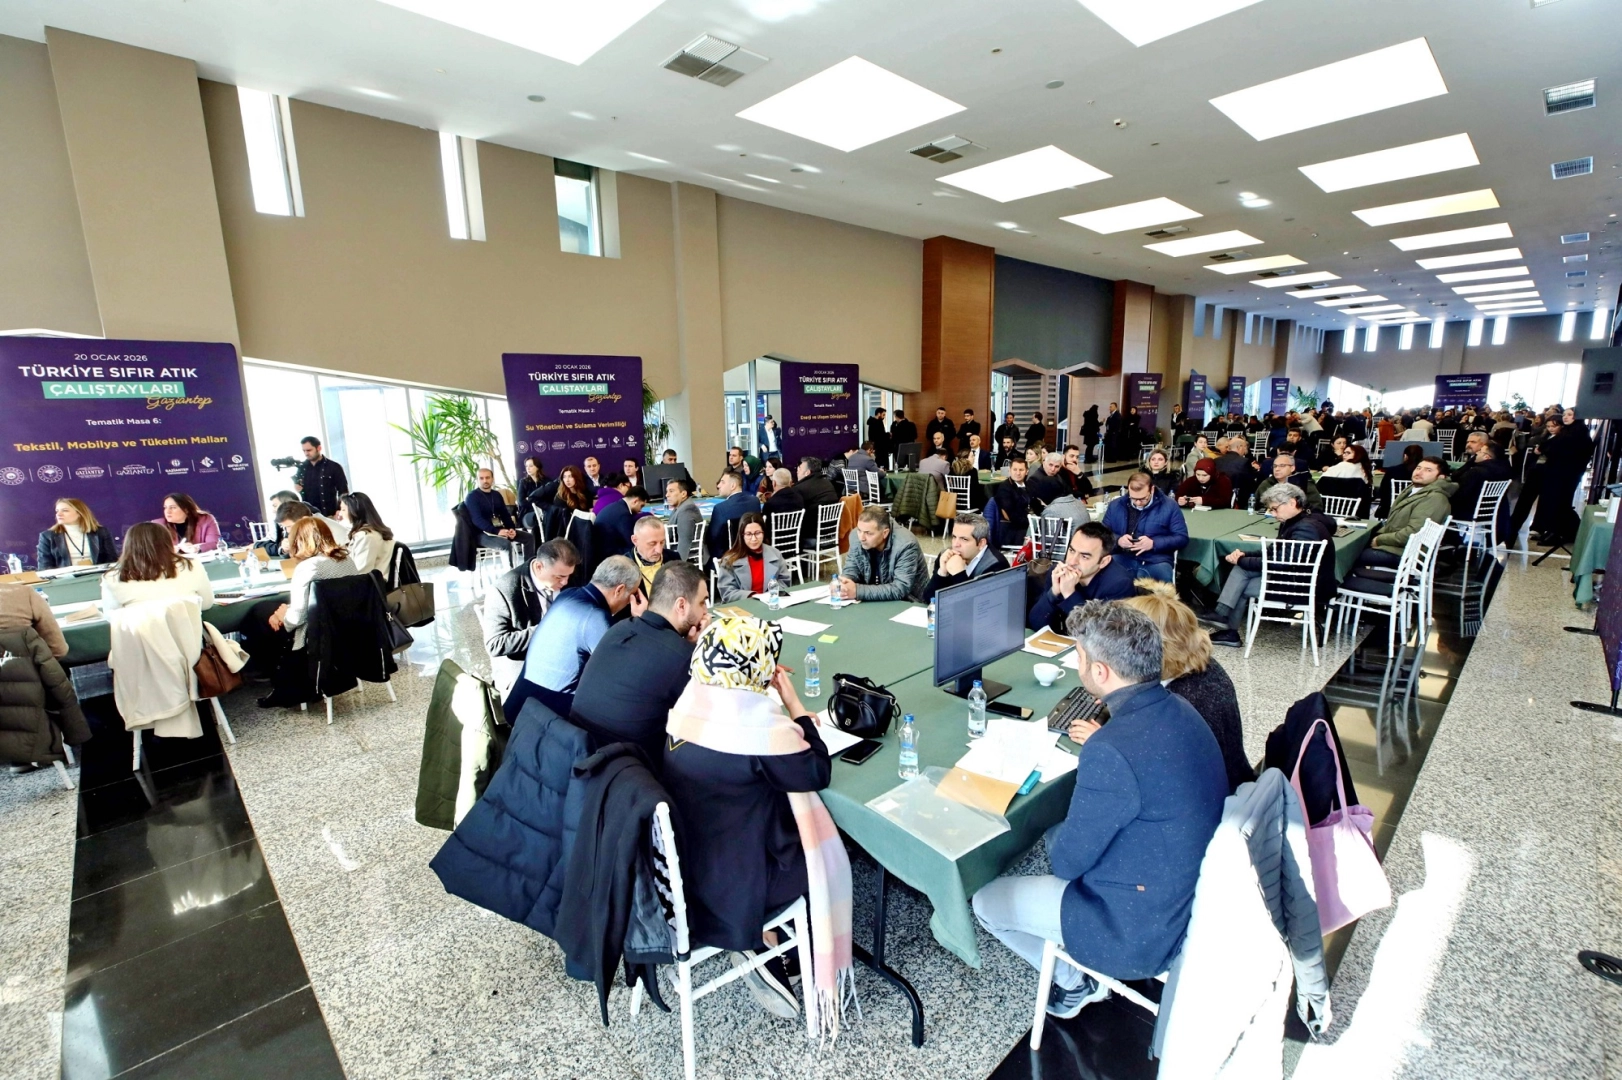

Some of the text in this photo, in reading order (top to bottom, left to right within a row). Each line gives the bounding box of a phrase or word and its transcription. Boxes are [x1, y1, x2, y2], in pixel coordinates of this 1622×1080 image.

[124, 354, 148, 362] 2026
[18, 364, 198, 378] TÜRKİYE SIFIR ATIK
[528, 372, 569, 380] TÜRKİYE
[49, 384, 179, 396] ÇALIŞTAYLARI
[542, 385, 605, 393] ÇALIŞTAYLARI
[146, 395, 213, 410] Gaziantep
[85, 418, 124, 426] Tematik
[152, 417, 162, 425] 6:
[13, 442, 64, 452] Tekstil,
[67, 440, 119, 451] Mobilya
[139, 436, 188, 447] Tüketim
[191, 436, 228, 444] Malları
